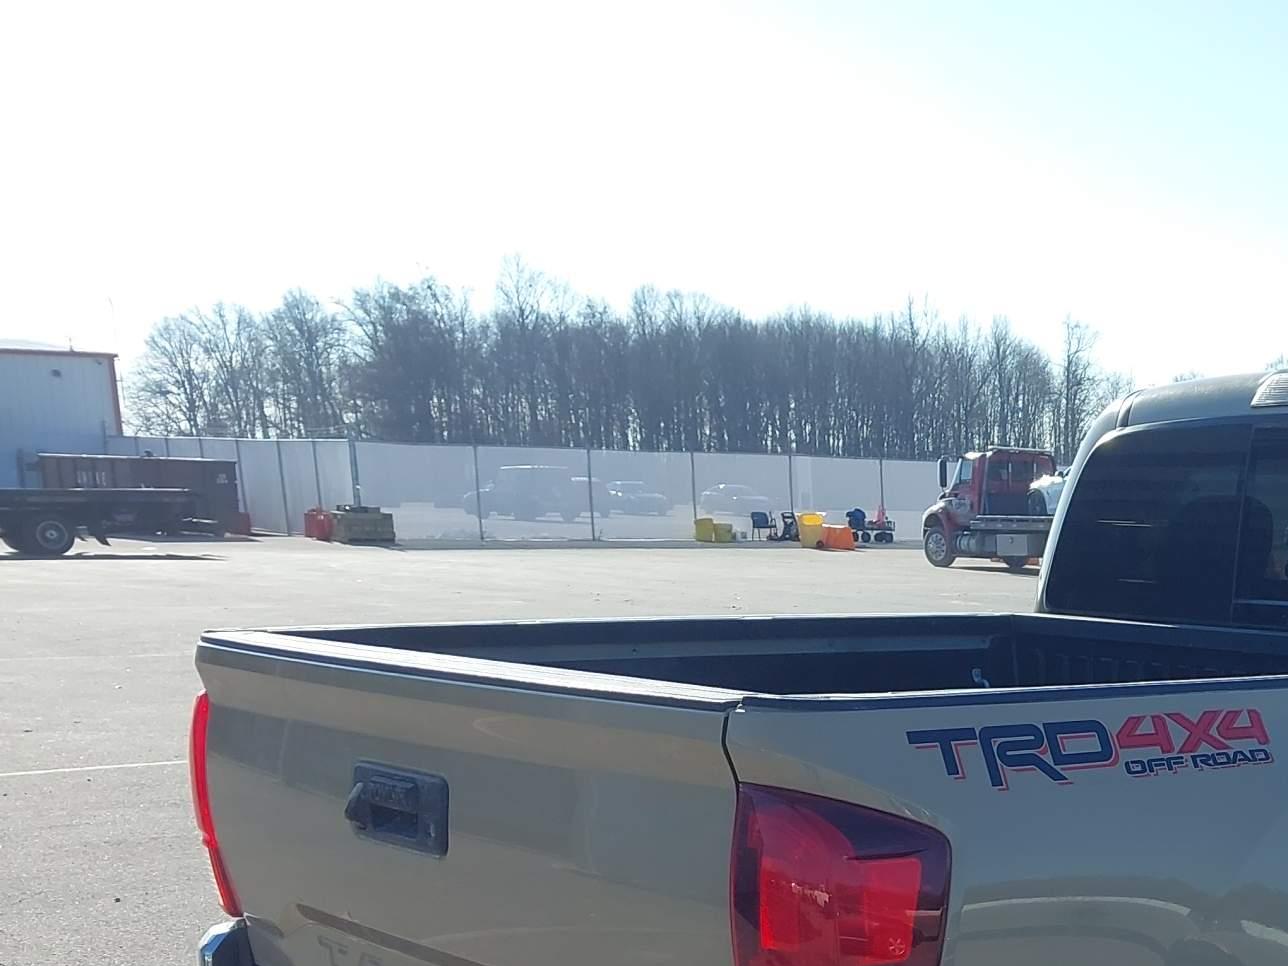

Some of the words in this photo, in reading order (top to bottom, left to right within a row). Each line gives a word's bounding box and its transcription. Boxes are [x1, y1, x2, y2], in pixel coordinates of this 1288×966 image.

[905, 718, 1119, 792] TRD
[1123, 755, 1189, 778] OFF
[1191, 746, 1275, 773] ROAD
